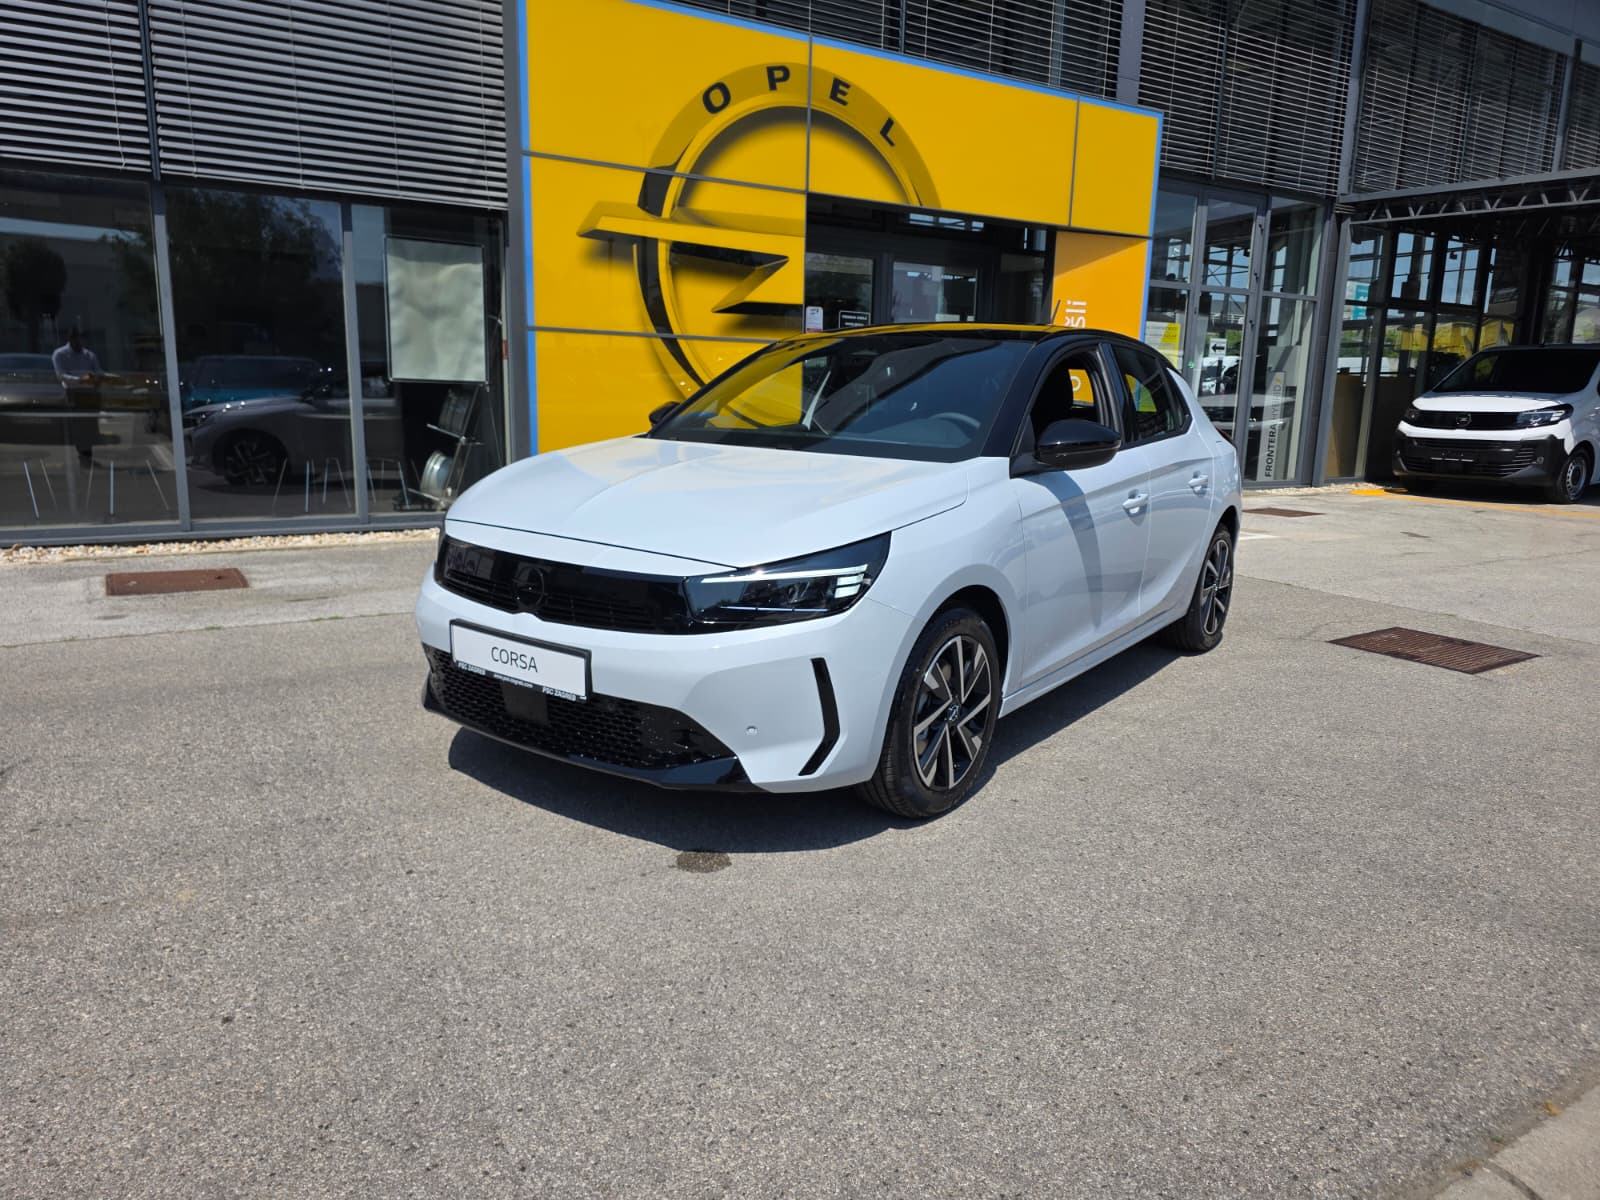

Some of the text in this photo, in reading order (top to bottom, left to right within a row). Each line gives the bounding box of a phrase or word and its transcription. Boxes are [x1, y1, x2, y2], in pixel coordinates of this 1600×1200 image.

[702, 65, 895, 147] OPEL
[1065, 300, 1087, 328] šli
[1264, 423, 1278, 478] FRONTERA
[491, 646, 538, 673] CORSA
